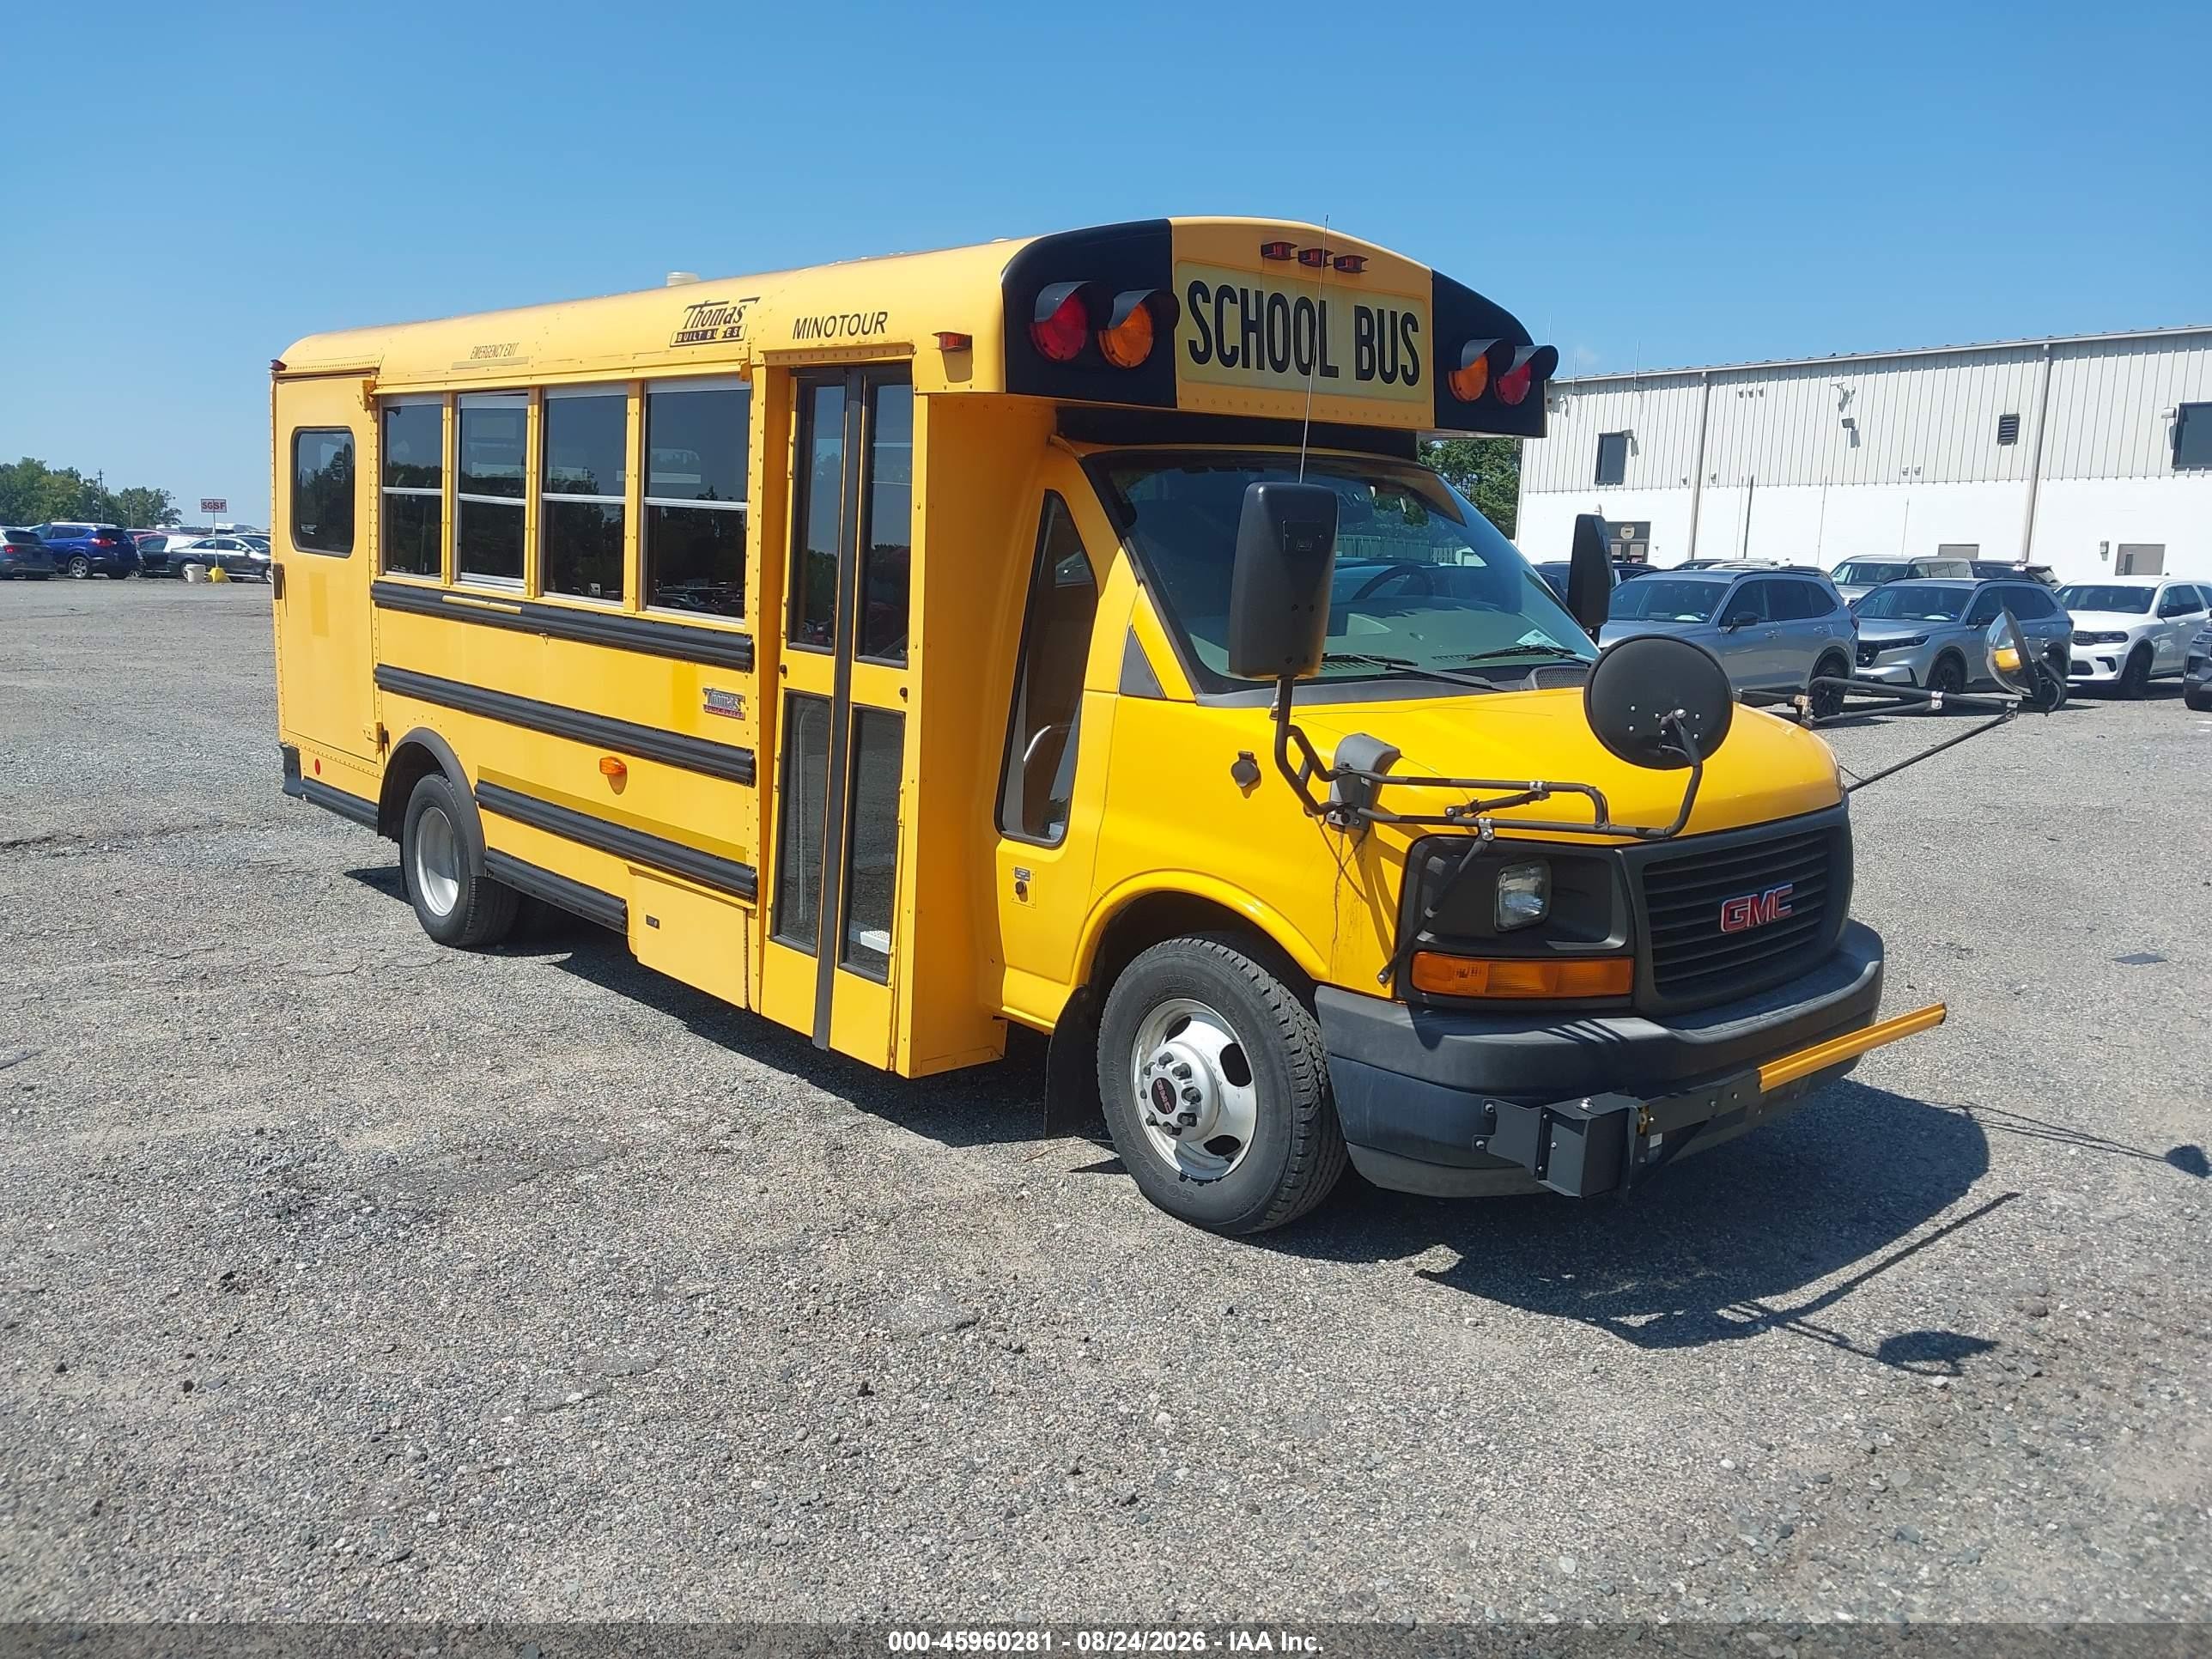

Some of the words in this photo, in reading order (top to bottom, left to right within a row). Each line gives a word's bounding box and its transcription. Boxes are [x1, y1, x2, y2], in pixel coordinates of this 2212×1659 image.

[683, 297, 760, 329] Thomas
[793, 311, 888, 340] MINOTOUR
[677, 331, 703, 343] BUILT
[706, 327, 739, 340] BUES
[1187, 280, 1340, 379] SCHOOL
[1353, 305, 1420, 386] BUS
[470, 343, 505, 360] EMERGENCY
[502, 341, 520, 357] EXIT
[202, 501, 226, 510] SGSF
[1720, 884, 1793, 933] GMC
[1156, 1079, 1173, 1114] GMC
